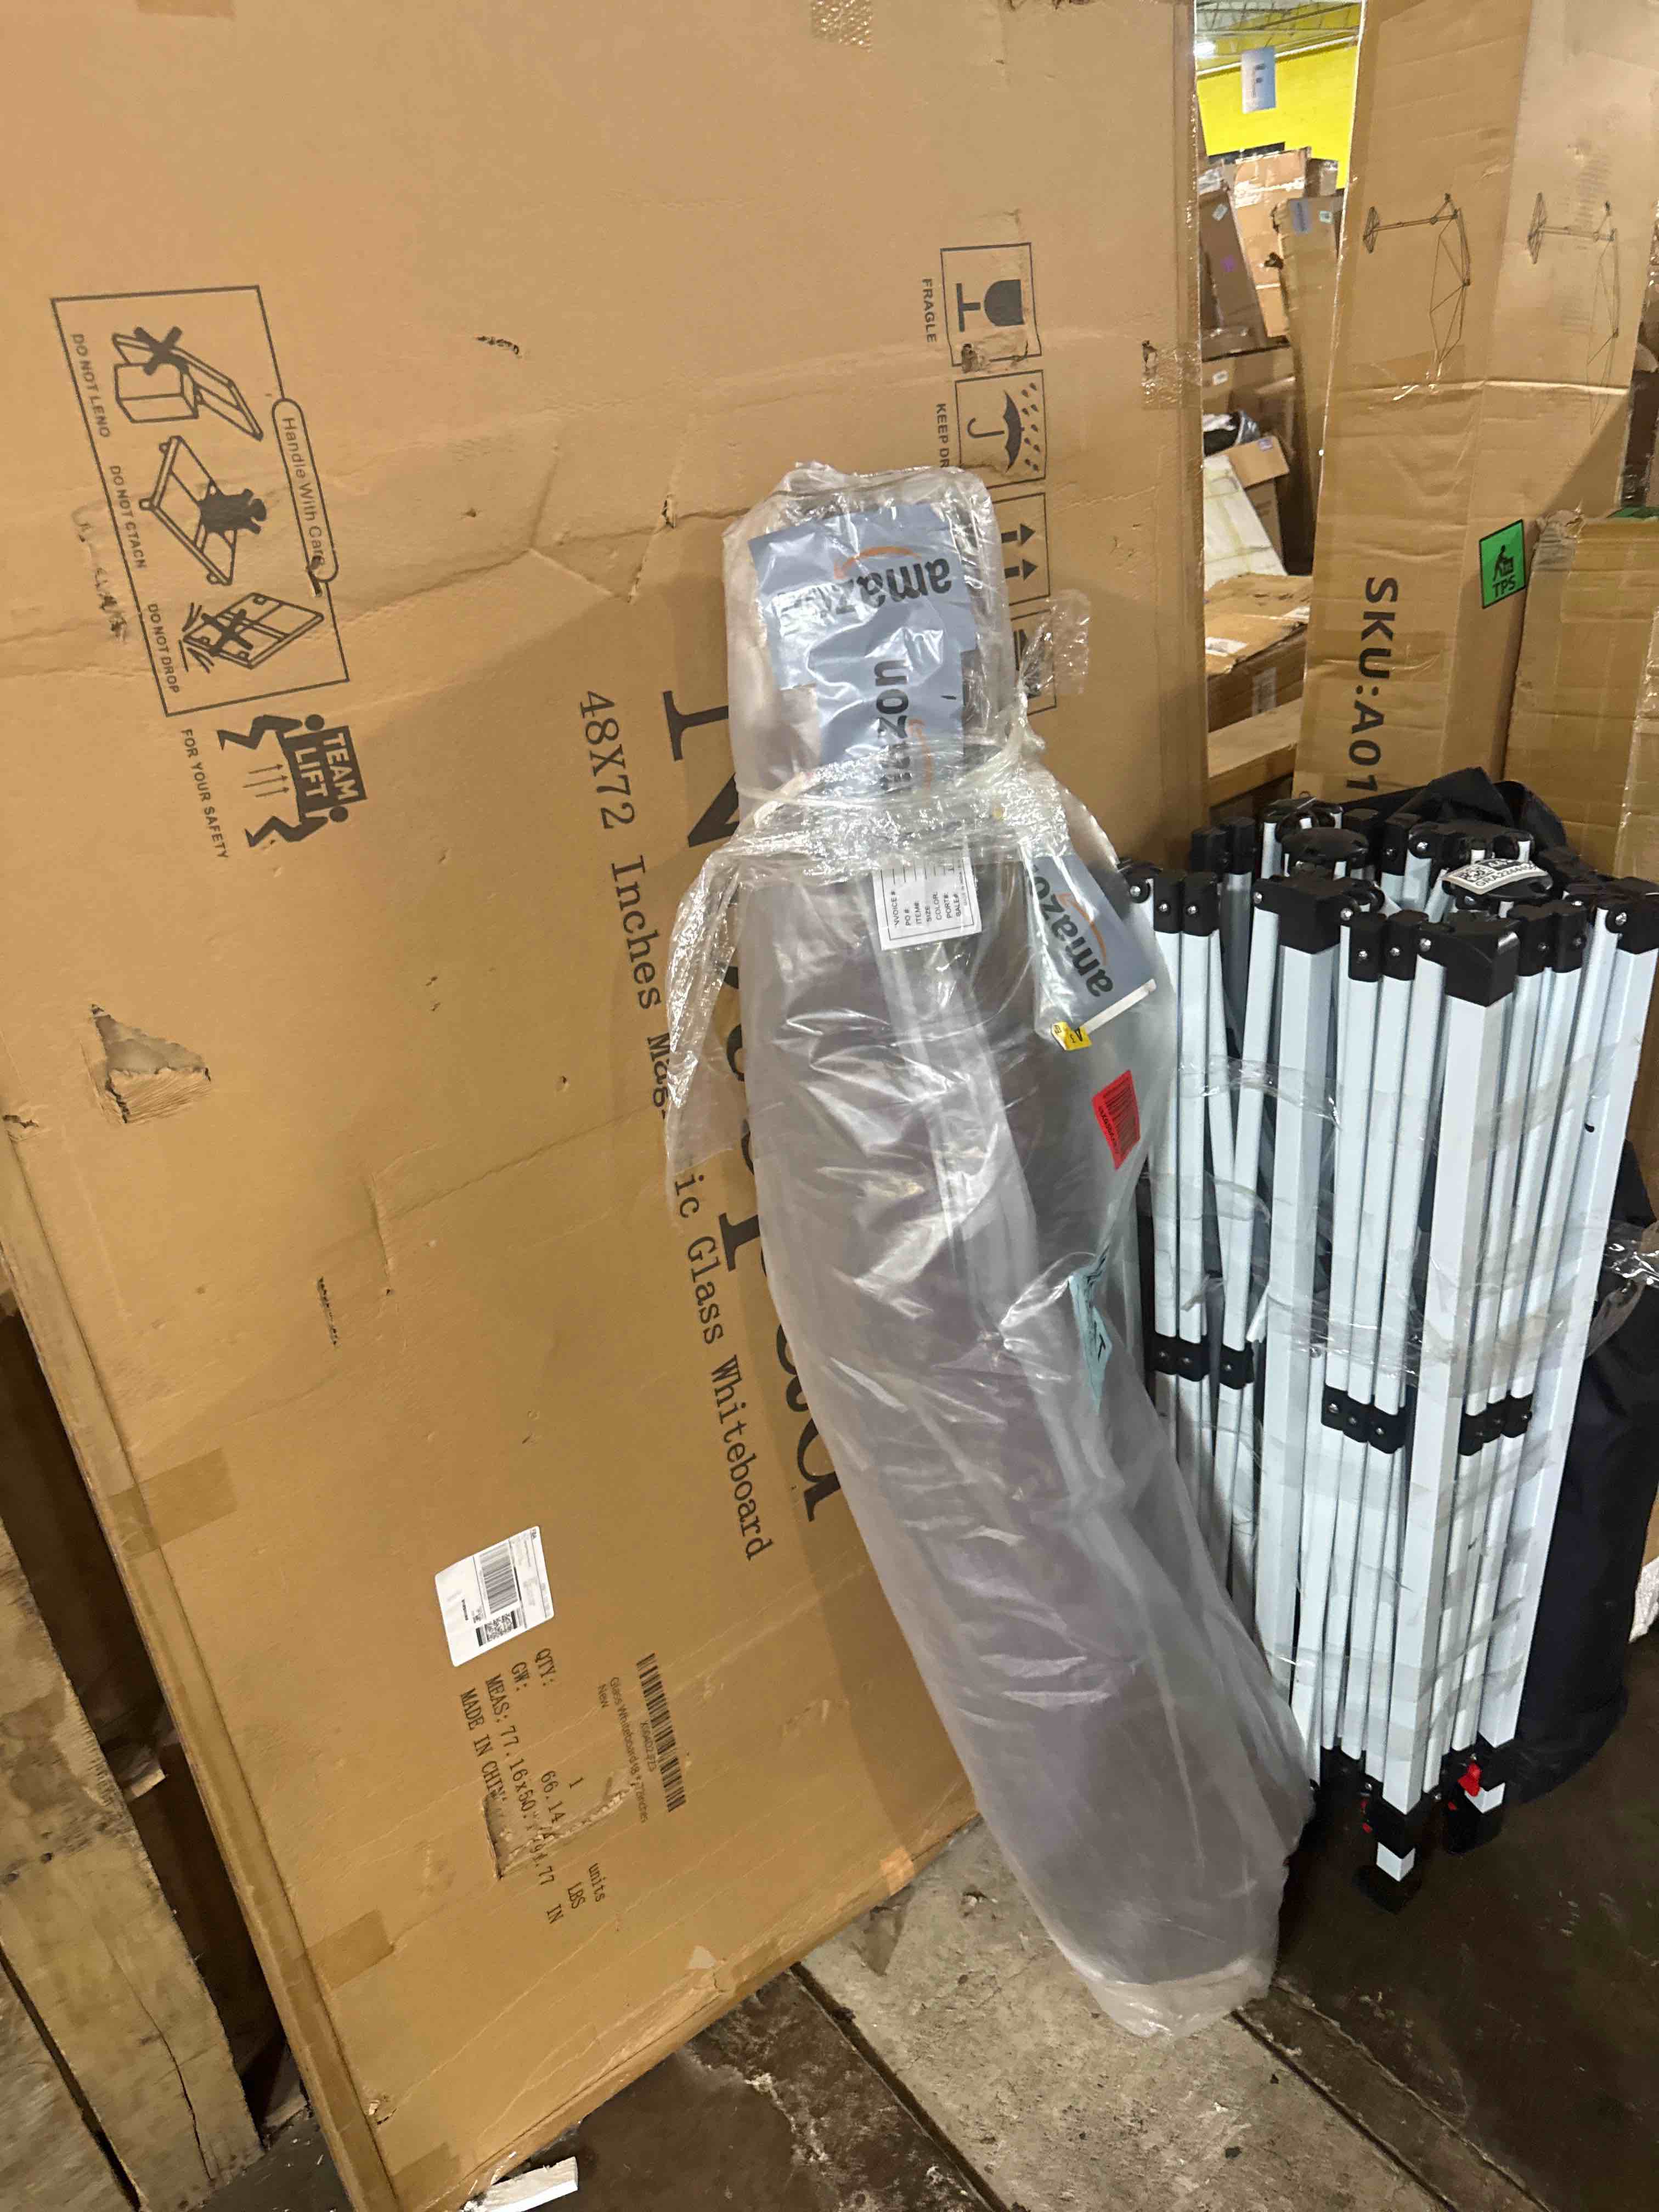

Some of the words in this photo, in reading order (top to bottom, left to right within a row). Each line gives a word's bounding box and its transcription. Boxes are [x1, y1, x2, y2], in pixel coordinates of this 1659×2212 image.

[72, 334, 88, 356] DO
[80, 360, 99, 392] NOT
[936, 403, 949, 444] KEEP
[939, 447, 950, 468] DR
[110, 465, 124, 486] DO
[117, 489, 134, 518] NOT
[282, 417, 306, 479] Handle
[299, 482, 317, 521] With
[309, 525, 325, 567] Care
[148, 603, 161, 623] DO
[1492, 574, 1516, 598] TPS
[153, 626, 170, 652] NOT
[161, 656, 180, 693] DROP
[181, 728, 199, 758] FOR
[191, 761, 211, 802] YOUR
[204, 805, 229, 859] SAFETY
[294, 747, 329, 797] LIFT
[323, 732, 359, 800] TEAM
[1030, 864, 1114, 997] amazo
[580, 691, 635, 830] 48X72
[611, 854, 662, 1010] Inches
[687, 1235, 724, 1345] Glass
[711, 1355, 774, 1561] Whiteboard
[460, 1687, 484, 1731] MADE
[473, 1734, 494, 1758] IN
[484, 1673, 510, 1723] MEAS:
[546, 1903, 564, 1925] IN
[511, 1661, 531, 1691] GW:
[541, 1770, 566, 1823] 66.14
[567, 1881, 586, 1910] LBS
[534, 1647, 556, 1686] QTY:
[588, 1862, 607, 1903] units
